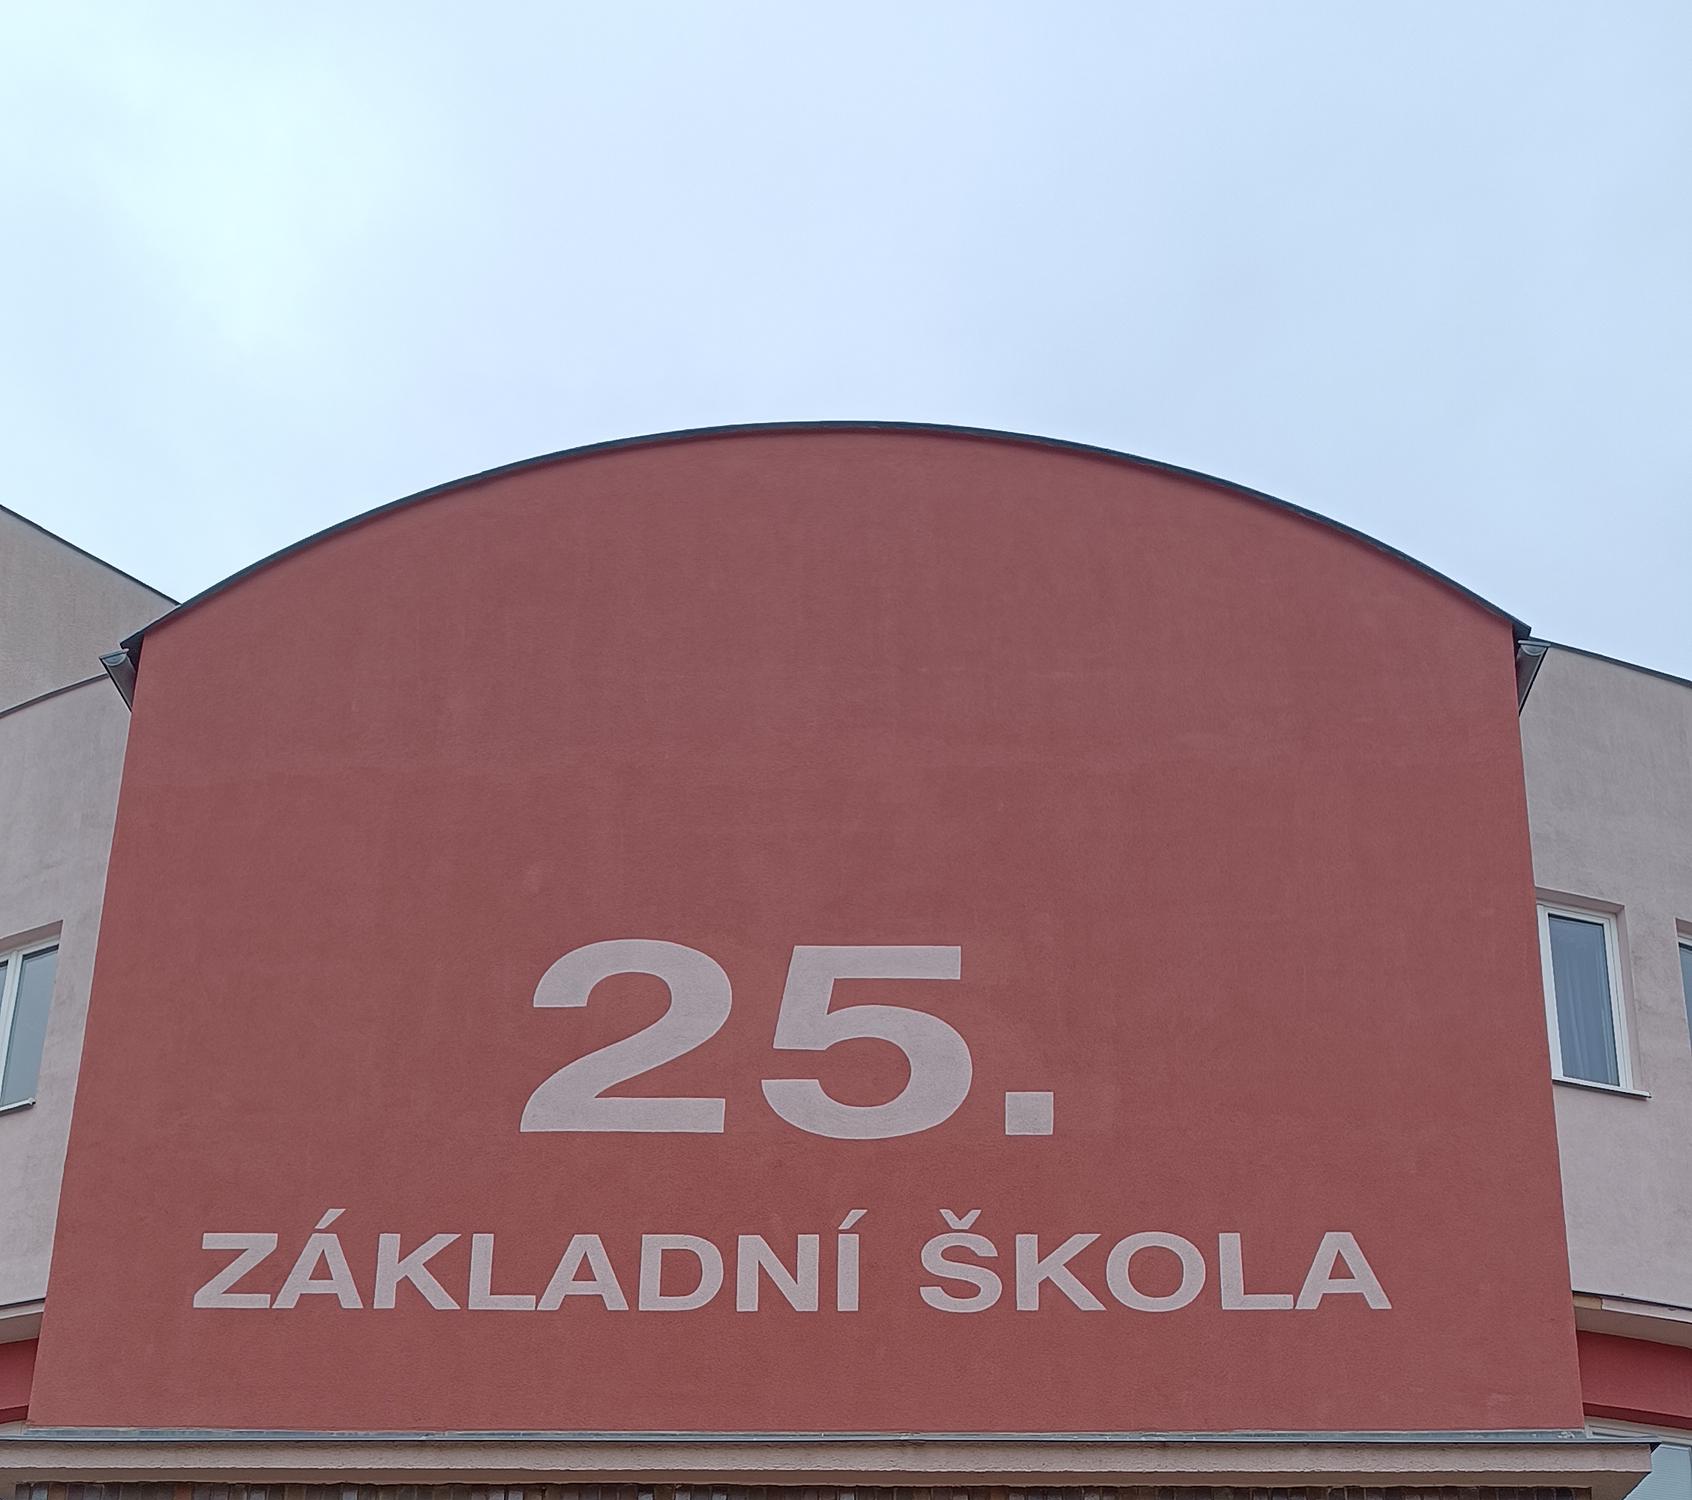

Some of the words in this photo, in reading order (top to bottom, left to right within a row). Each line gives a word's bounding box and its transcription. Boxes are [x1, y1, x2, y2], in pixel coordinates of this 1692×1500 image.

[520, 938, 1054, 1140] 25.
[191, 1207, 869, 1313] ZÁKLADNÍ
[918, 1207, 1394, 1313] ŠKOLA
